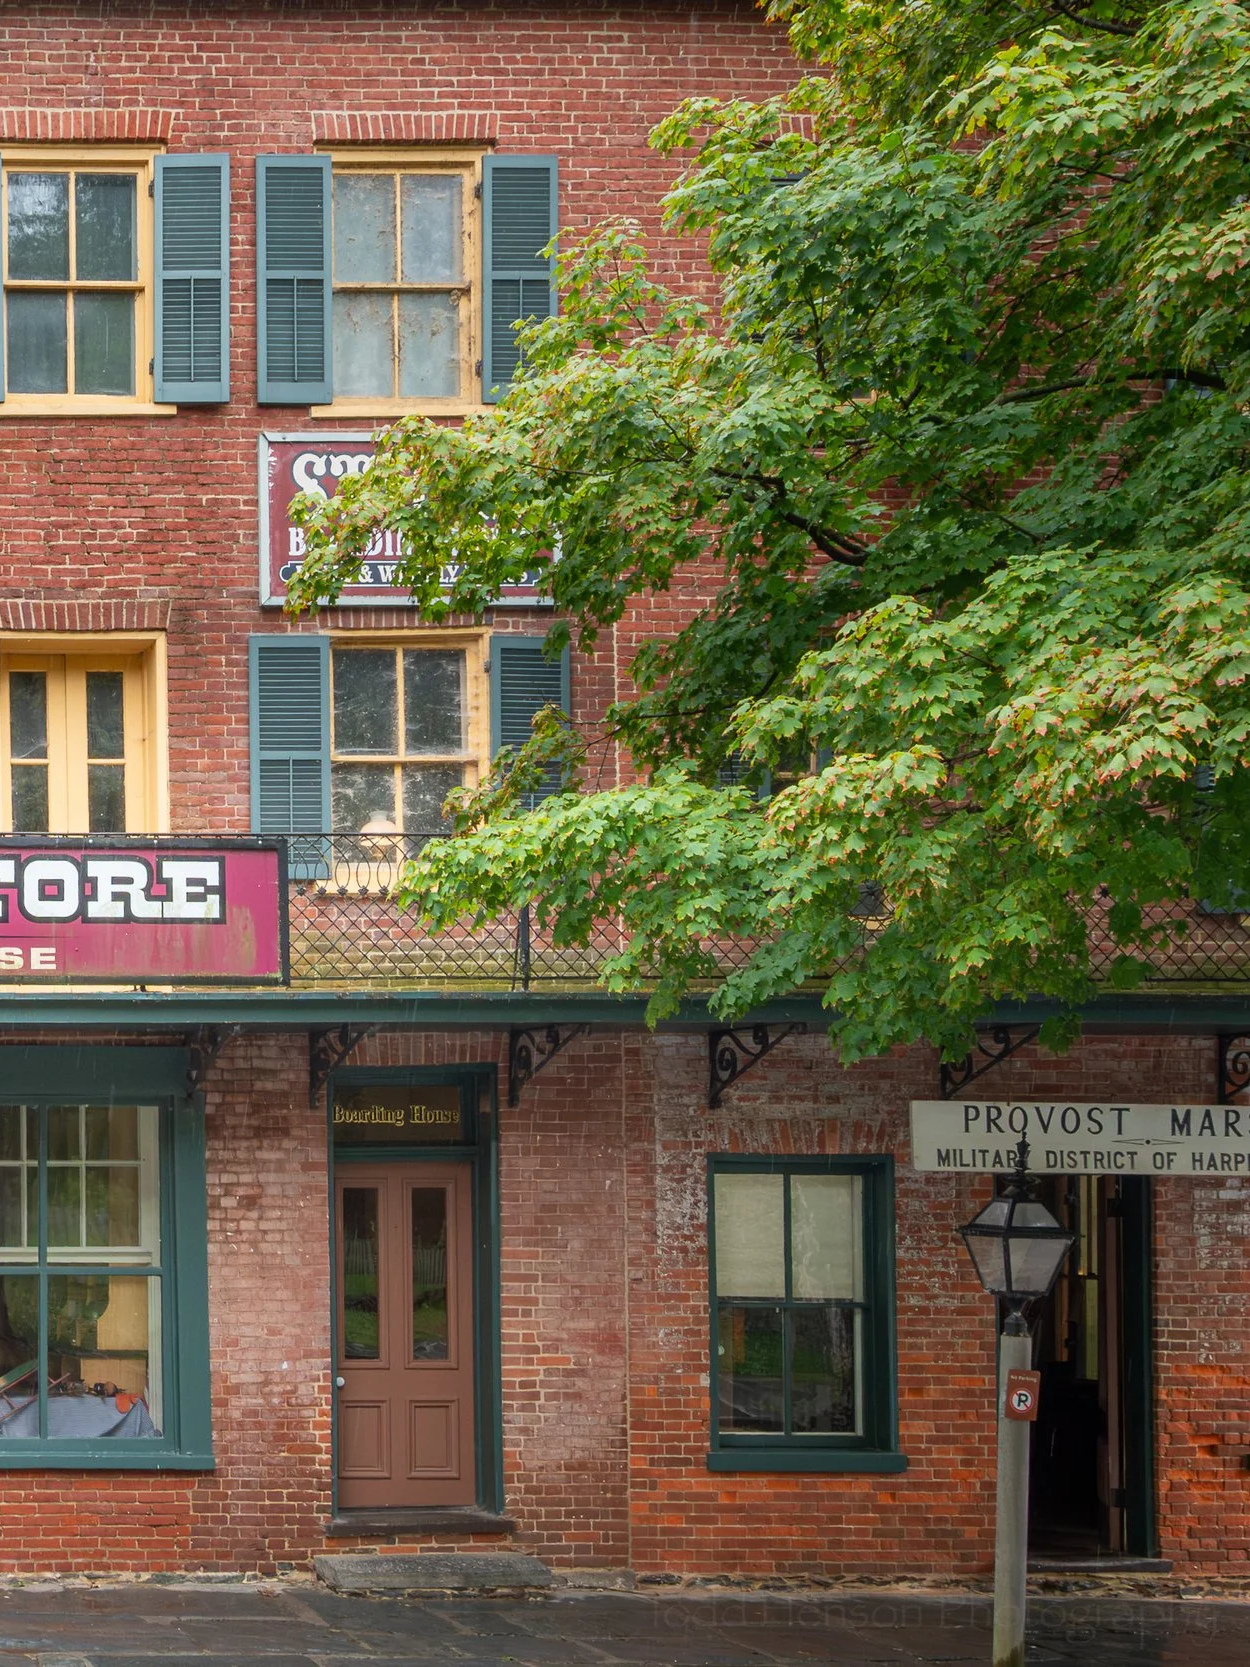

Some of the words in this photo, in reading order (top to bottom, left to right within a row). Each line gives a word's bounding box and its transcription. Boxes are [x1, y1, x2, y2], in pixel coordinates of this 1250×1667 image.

[333, 1105, 405, 1126] Boarding
[409, 1105, 460, 1123] House
[962, 1104, 1131, 1136] PROVOST
[1170, 1108, 1250, 1138] MAR
[1045, 1149, 1138, 1170] DISTRICT
[1152, 1151, 1178, 1171] OF
[1191, 1151, 1250, 1172] HARP
